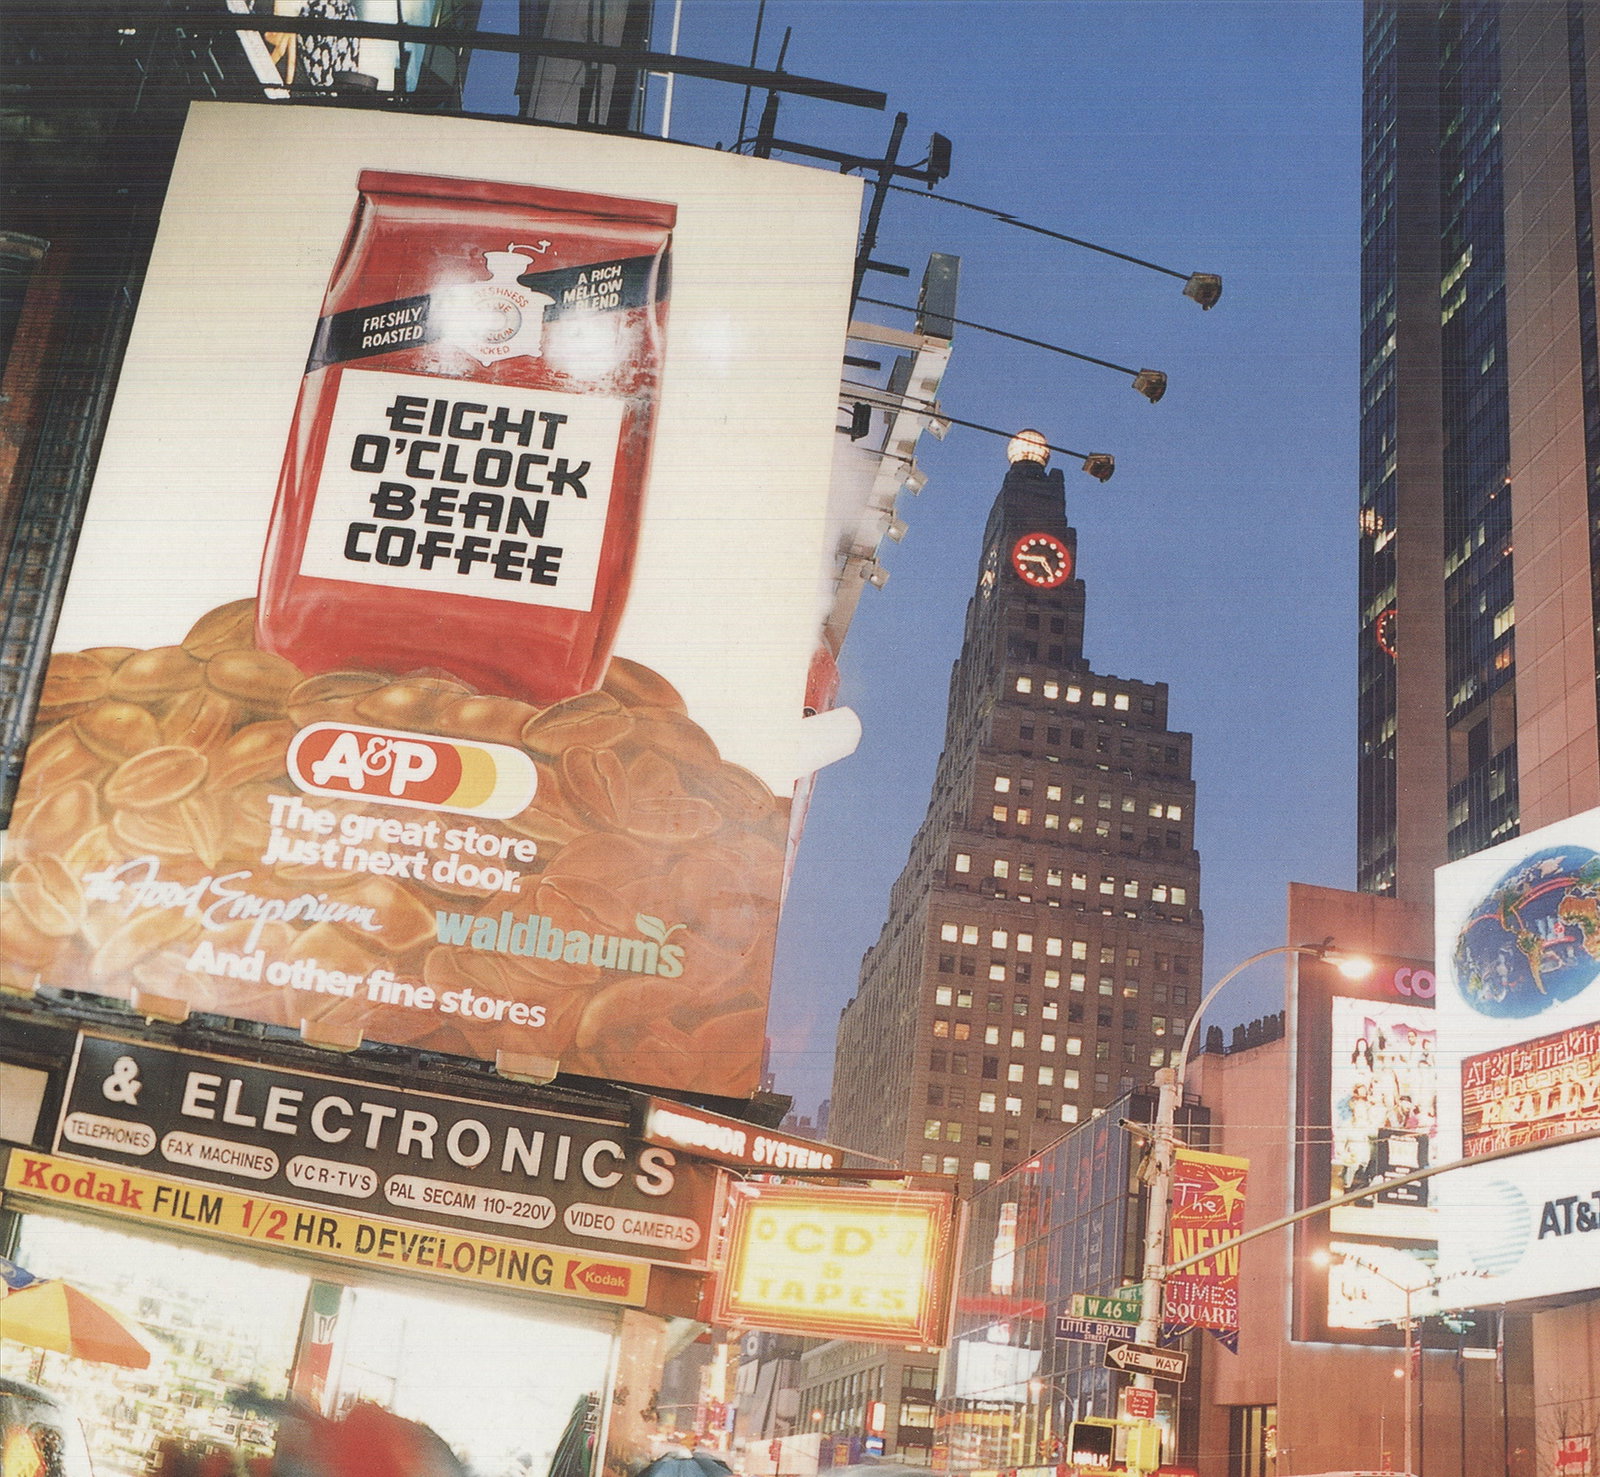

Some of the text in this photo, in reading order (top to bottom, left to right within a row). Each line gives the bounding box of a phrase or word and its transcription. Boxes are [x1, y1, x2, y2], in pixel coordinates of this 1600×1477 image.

[562, 278, 624, 304] MELLOW
[577, 265, 623, 286] A RICH
[575, 293, 620, 312] BLEND
[362, 306, 423, 333] FRESHLY
[361, 325, 423, 350] ROASTED
[386, 395, 568, 450] EIGHT
[350, 433, 592, 499] O'CLOCK
[370, 481, 549, 539] BEAN
[344, 522, 564, 587] COFFEE
[311, 732, 437, 795] A&P
[267, 795, 537, 862] The great store
[261, 828, 520, 893] just next door.
[112, 855, 212, 917] Food
[201, 870, 383, 953] Emporium
[186, 941, 546, 1028] And other fine stores
[71, 1120, 150, 1147] TELEPHONES
[102, 1056, 677, 1196] & ELECTRONICS
[167, 1139, 273, 1172] FAX MACHINES
[753, 1136, 833, 1169] SYSTEMS
[390, 1182, 551, 1221] PAL SECAM 110-220V
[1173, 1183, 1217, 1213] The
[19, 1159, 626, 1288] Kodak FILM 1/2 HR. DEVELOPING Kodak
[570, 1210, 694, 1242] VIDEO CAMERAS
[1173, 1228, 1240, 1276] NEW
[754, 1277, 906, 1311] TAPES
[1088, 1299, 1138, 1318] W 46 ST
[1168, 1280, 1237, 1306] TIMES
[1060, 1320, 1131, 1339] LITTLE BRAZIL
[1166, 1302, 1237, 1327] SQUARE
[1084, 1334, 1107, 1342] STREET
[1117, 1350, 1180, 1371] ONE WAY
